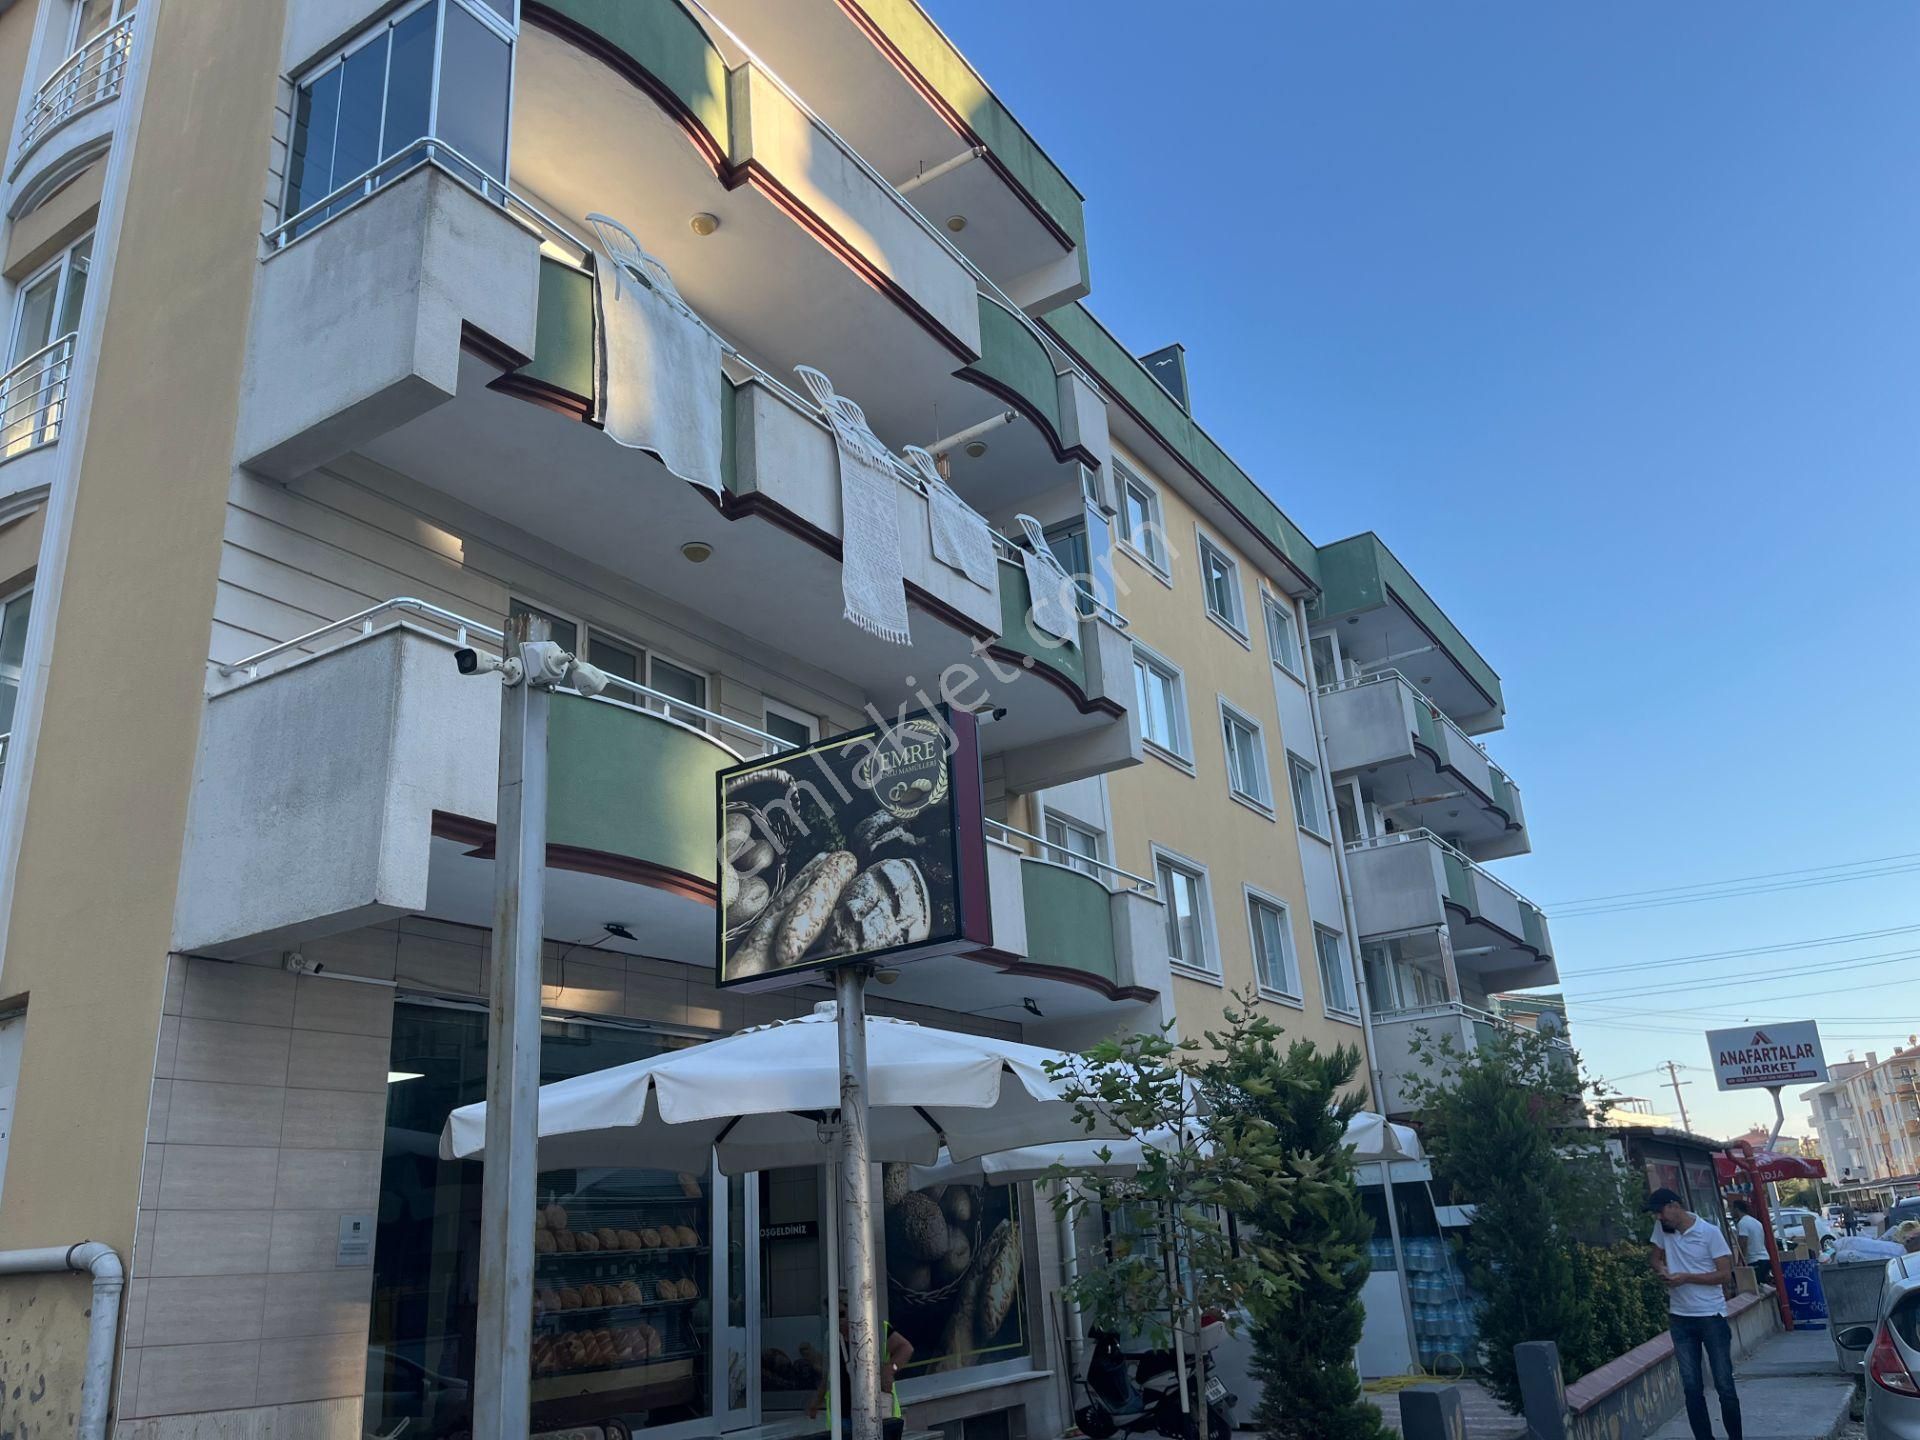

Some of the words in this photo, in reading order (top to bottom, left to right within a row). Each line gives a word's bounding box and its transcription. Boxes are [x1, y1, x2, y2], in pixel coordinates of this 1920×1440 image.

[879, 740, 936, 771] EMRE
[1719, 1043, 1815, 1067] ANAFARTALAR
[1741, 1061, 1797, 1076] MARKET
[760, 1224, 807, 1239] OŞGELDİNİZ
